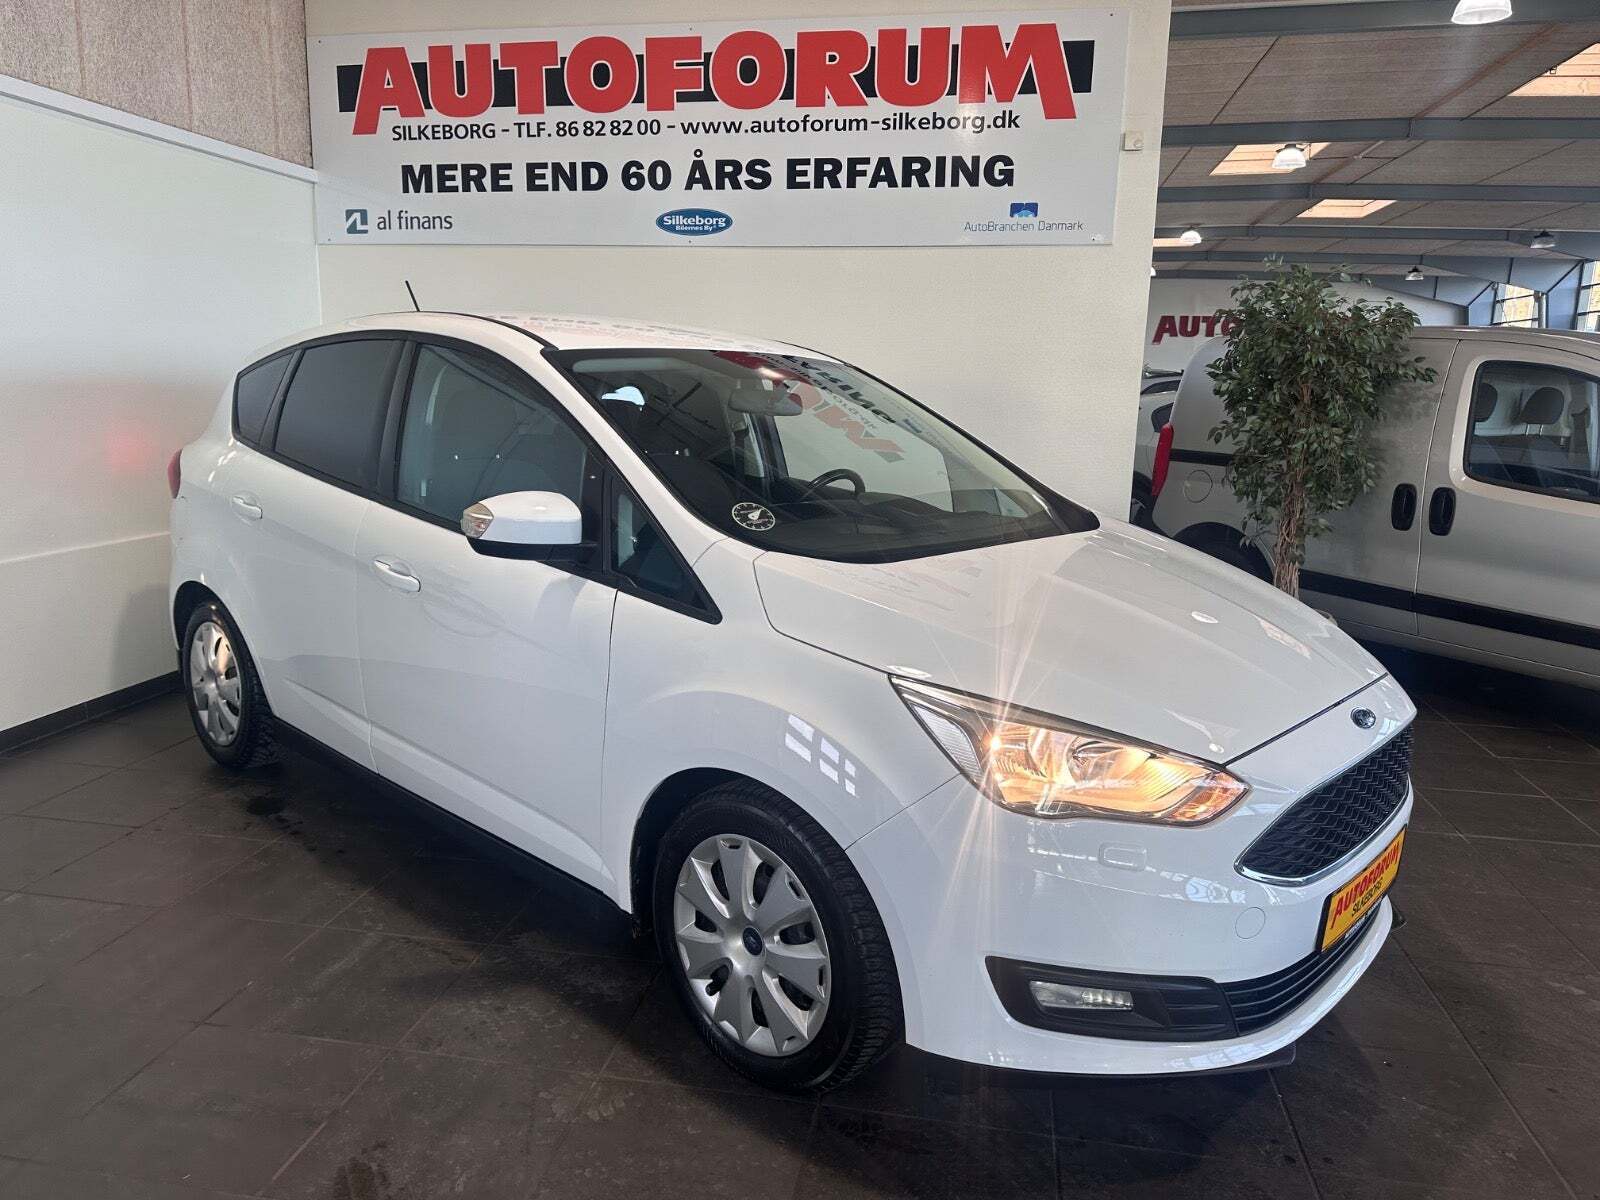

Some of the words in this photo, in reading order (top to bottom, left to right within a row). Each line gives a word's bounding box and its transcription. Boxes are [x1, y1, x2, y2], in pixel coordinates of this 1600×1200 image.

[352, 23, 1077, 135] AUTOFORUM
[391, 123, 496, 141] SILKEBORG
[513, 121, 551, 138] TLF.
[680, 110, 1021, 135] www.autoforum-silkeborg.dk
[401, 163, 513, 194] MERE
[525, 161, 608, 192] END
[621, 159, 672, 191] 60
[684, 149, 772, 191] ÅRS
[786, 154, 1015, 190] ERFARING
[376, 209, 392, 230] al
[397, 209, 453, 230] finans
[662, 214, 727, 228] Silkeborg
[963, 221, 1035, 232] AutoBranchen
[1037, 220, 1084, 231] Danmark
